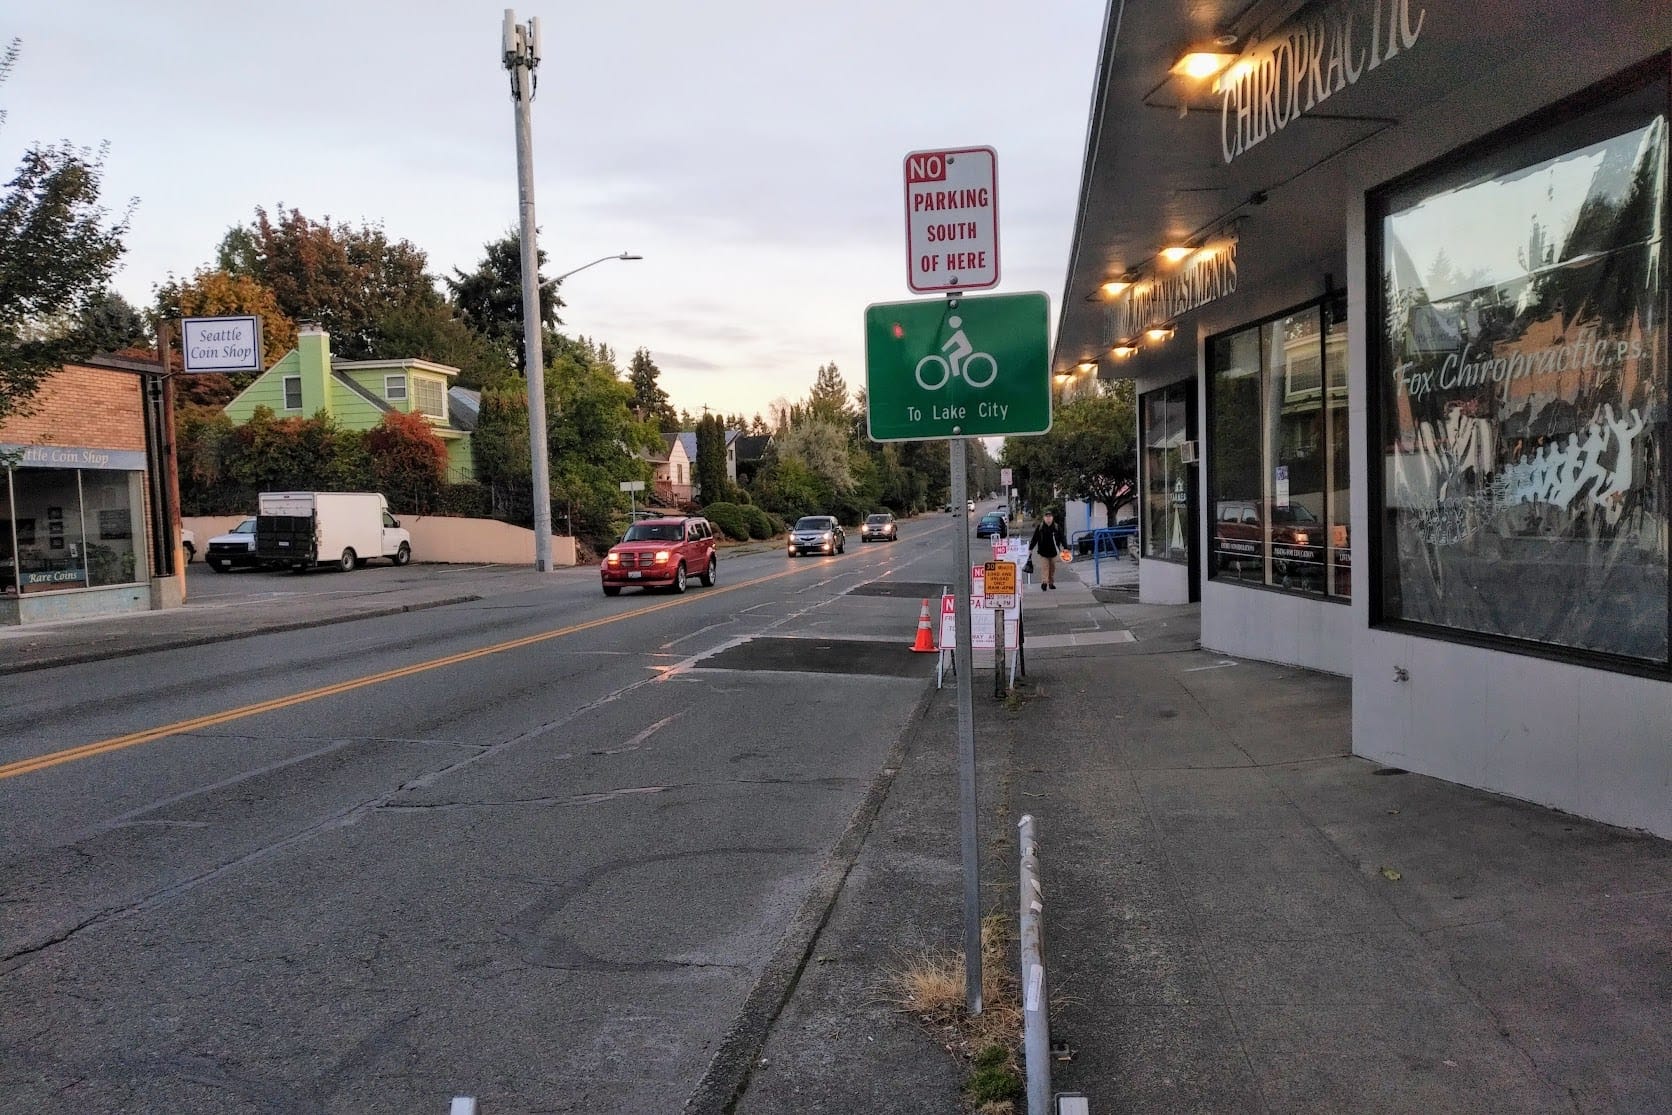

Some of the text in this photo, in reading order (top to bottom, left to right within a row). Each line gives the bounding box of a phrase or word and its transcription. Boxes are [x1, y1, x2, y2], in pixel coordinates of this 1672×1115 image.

[910, 156, 942, 179] NO
[914, 188, 989, 212] PARKING
[927, 222, 977, 242] SOUTH
[921, 251, 987, 273] OF HERE
[200, 327, 242, 342] Seattle
[191, 344, 252, 362] Coin Shop
[1393, 361, 1434, 403] Fox
[907, 402, 1008, 422] To Lake City
[52, 450, 78, 463] Coin
[82, 450, 109, 466] Shop
[29, 571, 77, 583] Rare Coins
[945, 598, 955, 611] N
